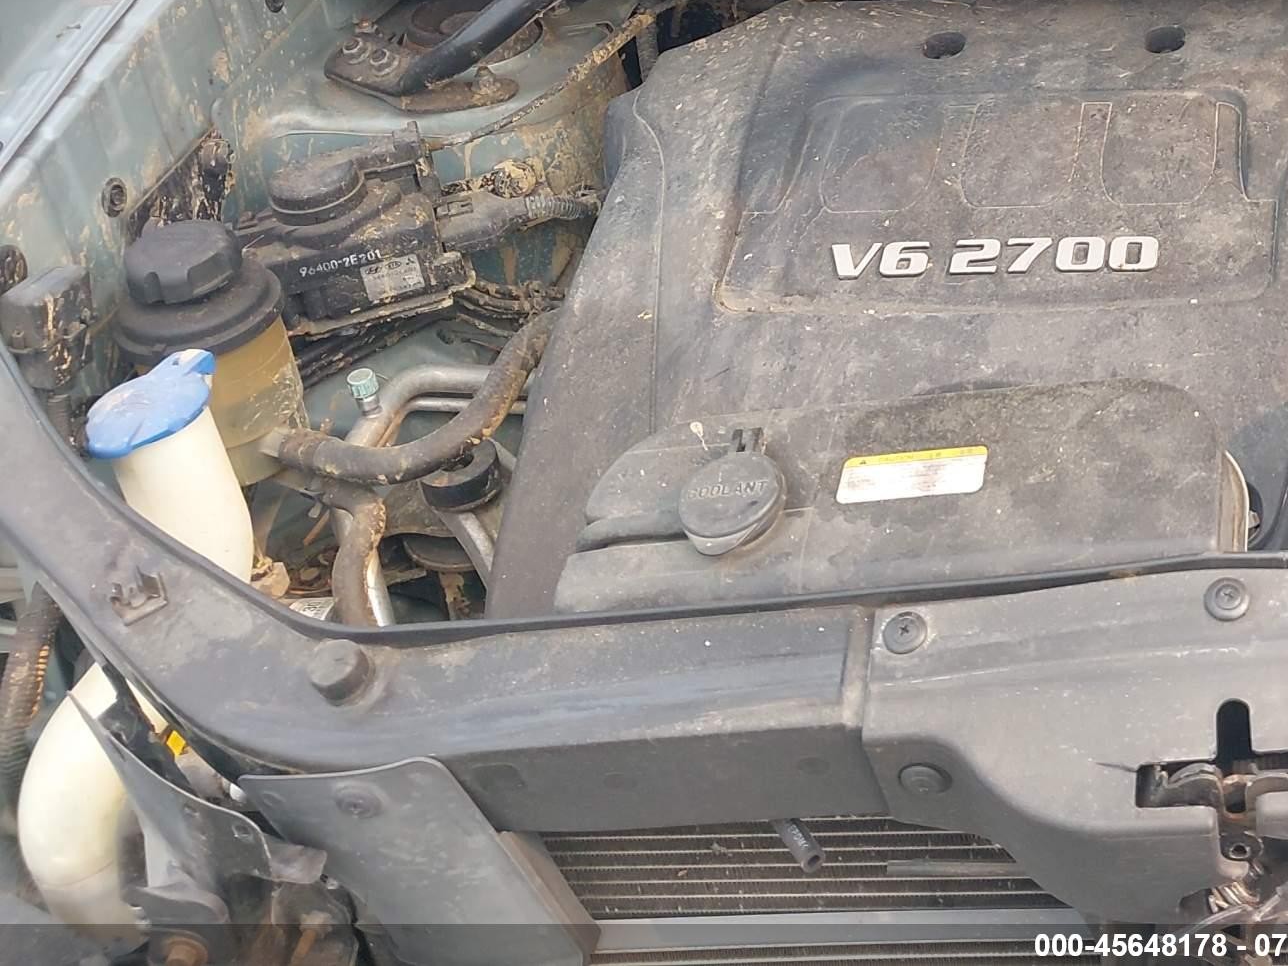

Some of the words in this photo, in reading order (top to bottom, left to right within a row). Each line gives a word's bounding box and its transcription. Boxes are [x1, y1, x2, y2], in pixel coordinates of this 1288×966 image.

[298, 248, 383, 278] 96400-2E201
[831, 240, 932, 280] V6
[949, 234, 1161, 277] 2700
[687, 479, 769, 500] COOLANT
